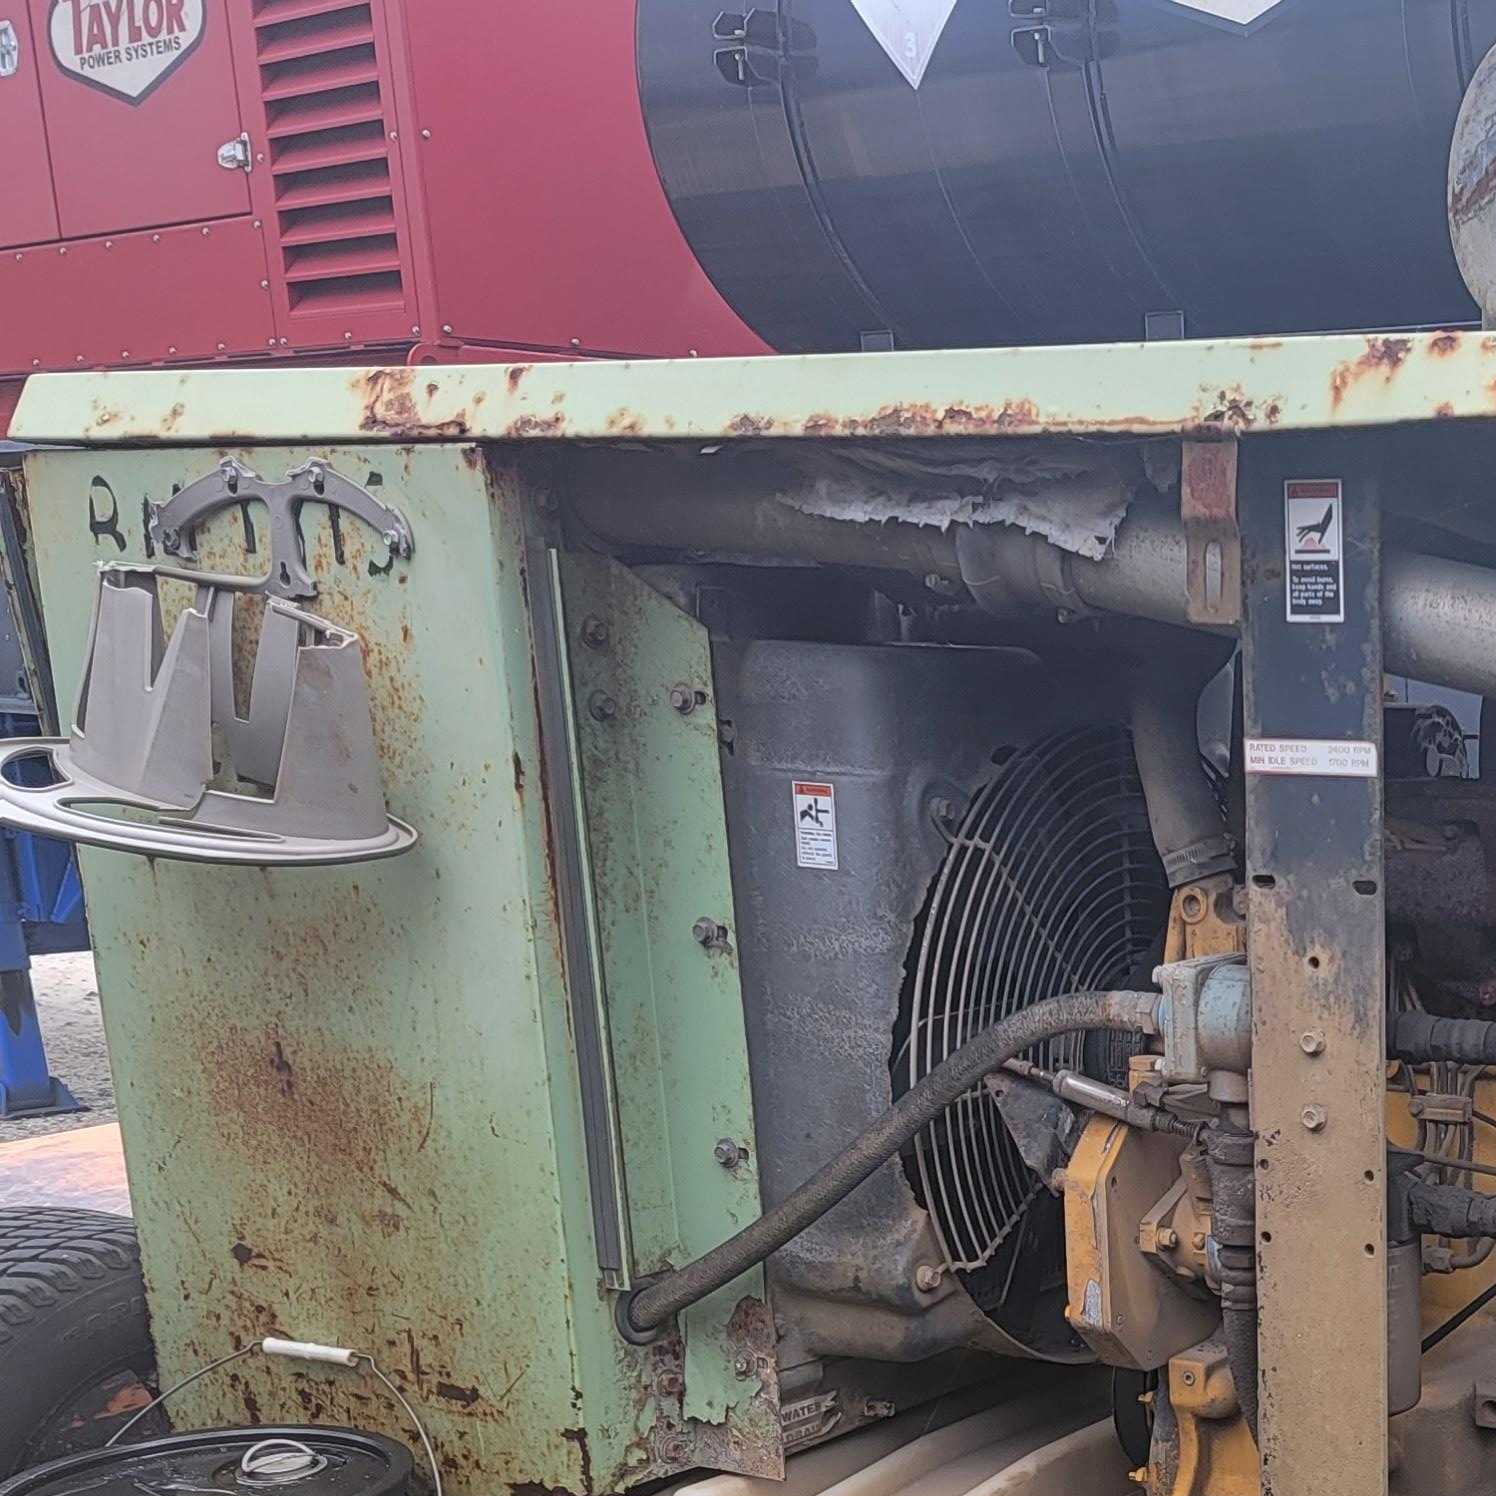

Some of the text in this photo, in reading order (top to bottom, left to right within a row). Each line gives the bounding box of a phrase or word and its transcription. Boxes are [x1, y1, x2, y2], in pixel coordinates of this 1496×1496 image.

[62, 0, 186, 56] TAYLOR
[79, 35, 182, 71] POWER SYSTEMS
[904, 31, 917, 58] 3
[1249, 743, 1276, 753] RATED
[1279, 743, 1307, 753] SPEED
[1268, 756, 1287, 766] IDLE
[1289, 756, 1318, 766] SPEED
